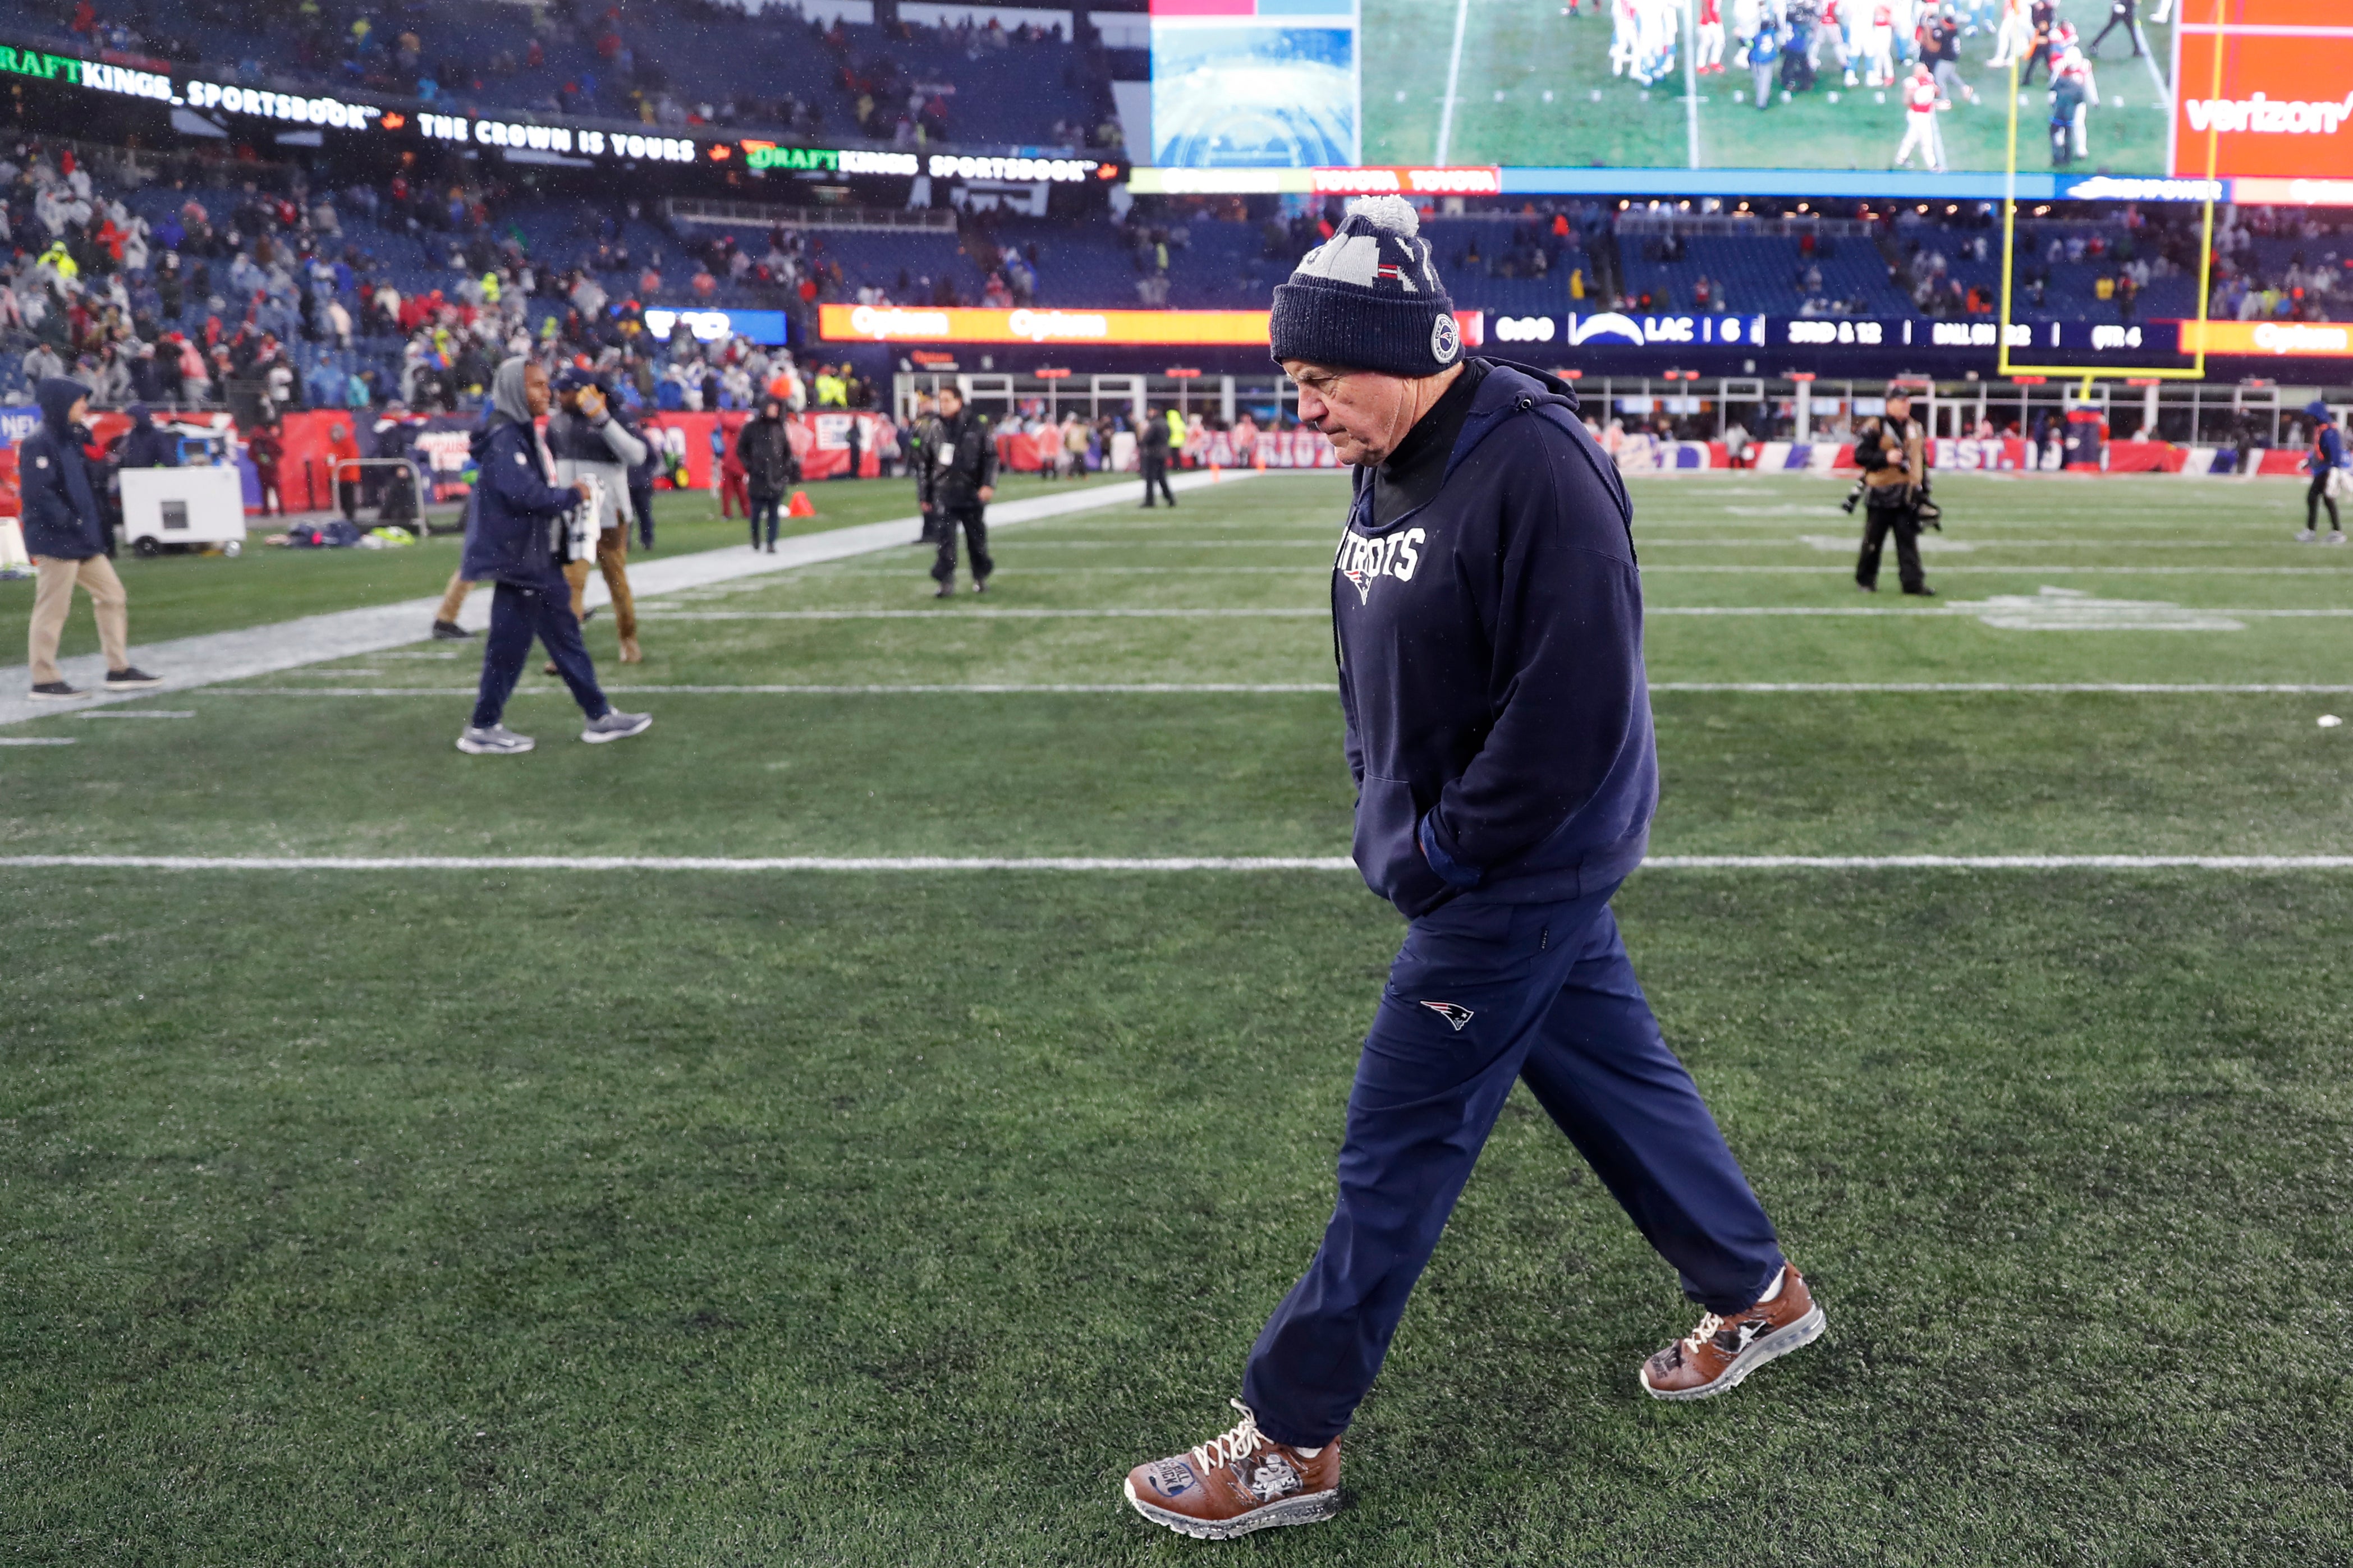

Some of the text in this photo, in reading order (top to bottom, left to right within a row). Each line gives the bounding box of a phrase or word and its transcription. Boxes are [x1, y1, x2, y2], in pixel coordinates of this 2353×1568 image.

[0, 45, 368, 130] RAFTKINGS SPORTSBOOK
[2185, 91, 2339, 134] verizon
[417, 113, 696, 162] THE CROWN IS YOURS
[929, 155, 1085, 181] SPORTSBOOK
[1312, 170, 1400, 191] TOYOTA
[1409, 170, 1496, 191] TOYOTA
[852, 306, 948, 340] Optum
[1010, 309, 1106, 342] Optum
[1644, 317, 1741, 342] LAC 6
[2125, 327, 2142, 348] 4
[2255, 323, 2347, 354] Optum
[1935, 439, 2015, 470] EST.
